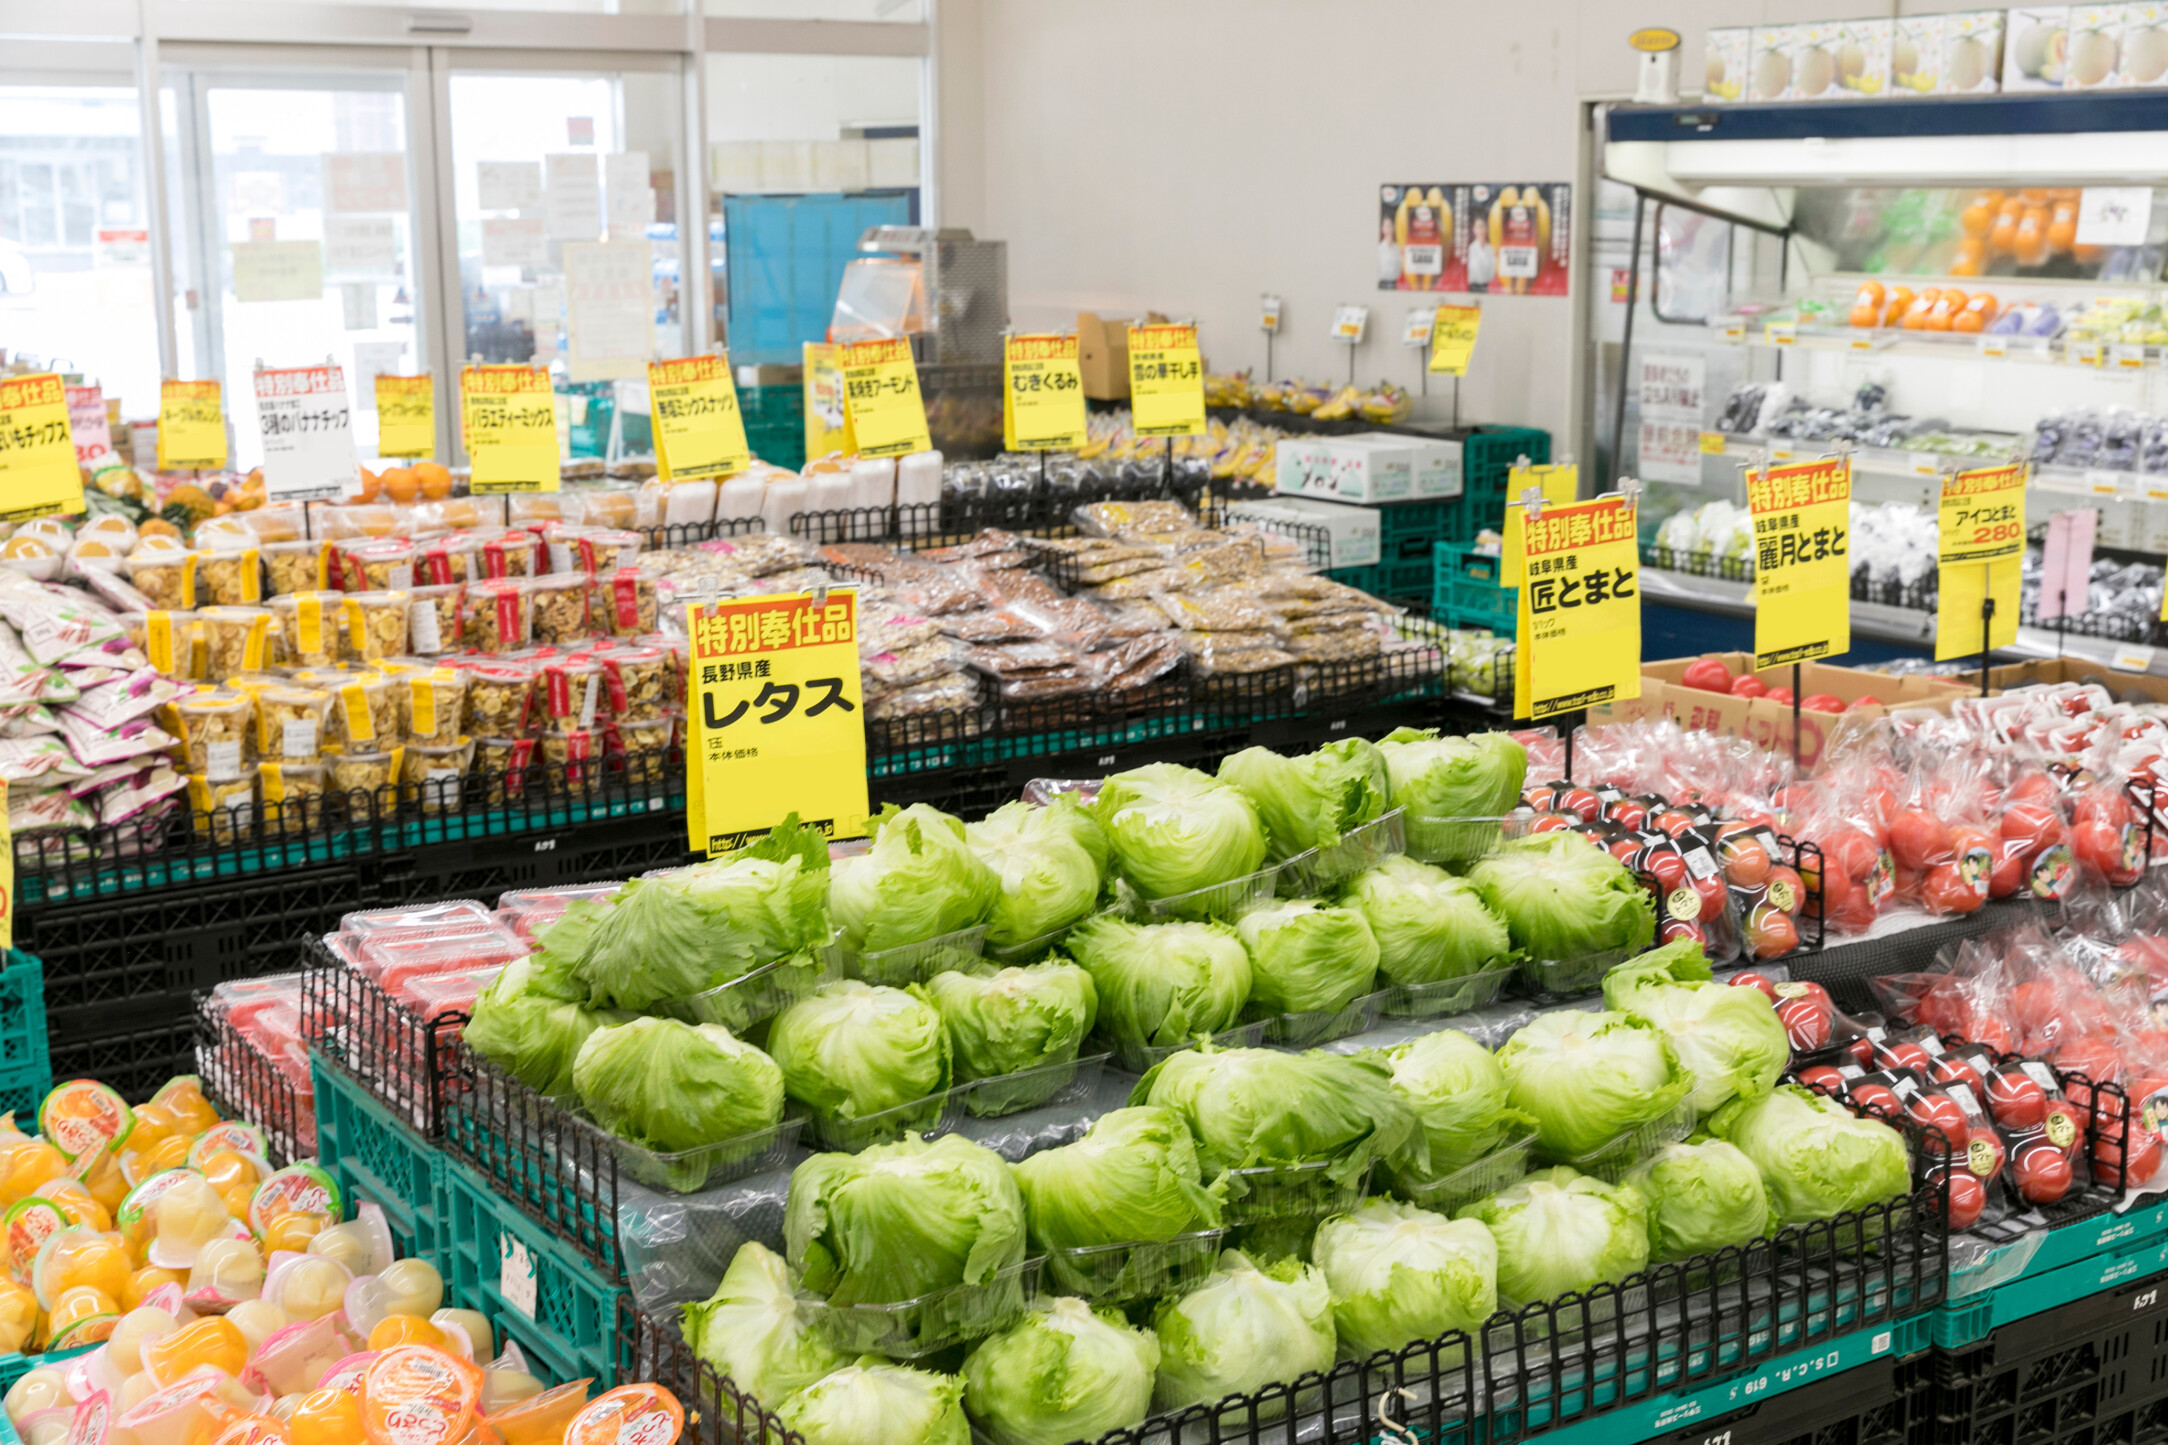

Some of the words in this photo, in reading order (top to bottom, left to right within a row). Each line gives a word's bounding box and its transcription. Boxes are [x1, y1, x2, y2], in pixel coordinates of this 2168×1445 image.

[1009, 338, 1077, 360] 特別奉仕品
[256, 371, 345, 395] 特別奉仕品
[467, 371, 551, 392] 特別奉仕品
[1013, 372, 1078, 392] むきくるみ
[1751, 469, 1848, 512] 特別奉仕品
[1756, 514, 1800, 533] 岐阜県産
[1956, 504, 2016, 527] アイコとまと
[1526, 508, 1634, 554] 特別奉仕品
[1973, 522, 2020, 544] 280
[1757, 526, 1846, 571] 麗月とまと
[1529, 555, 1578, 576] 岐阜県産
[1530, 567, 1635, 614] 匠とまと
[697, 603, 851, 656] 特別奉仕品
[702, 659, 772, 684] 長野県産
[703, 677, 855, 729] レタス
[708, 747, 759, 762] 本体価格
[1745, 1376, 1768, 1395] 619
